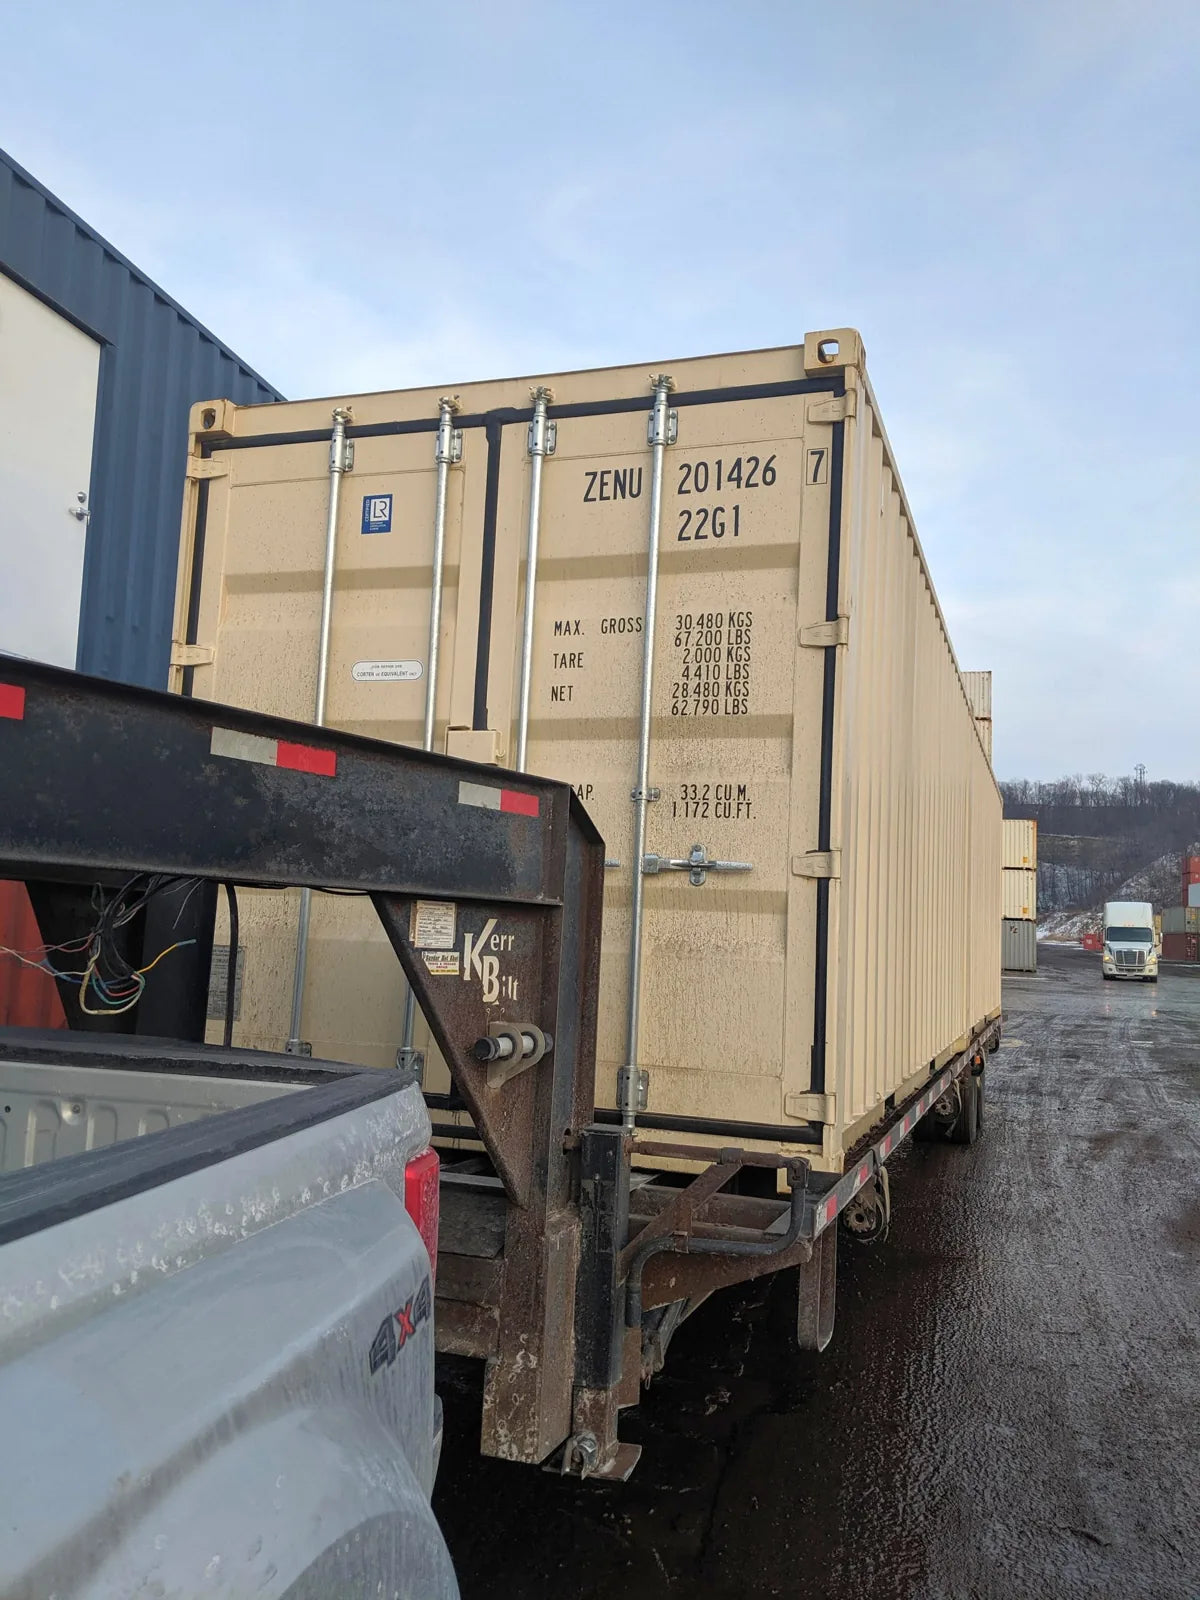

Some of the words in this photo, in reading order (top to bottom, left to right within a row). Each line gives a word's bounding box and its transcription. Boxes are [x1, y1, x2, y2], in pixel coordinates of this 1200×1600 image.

[583, 467, 643, 502] ZENU
[677, 454, 777, 494] 201426
[809, 450, 825, 482] 7
[373, 500, 387, 518] LR
[677, 505, 740, 541] 22G1
[554, 620, 585, 636] MAX.
[601, 617, 642, 634] GROSS
[728, 611, 753, 628] KGS
[727, 628, 751, 645] LBS
[553, 652, 584, 669] TARE
[727, 646, 751, 662] KGS
[726, 663, 749, 680] LBS
[551, 686, 574, 702] NET
[725, 681, 749, 697] KGS
[725, 698, 748, 715] LBS
[570, 784, 594, 801] AP.
[680, 784, 710, 801] 33.2
[715, 784, 750, 801] CU.M.
[714, 802, 756, 820] CU.FT.
[464, 918, 515, 981] Kerr
[482, 955, 519, 1005] Bilt
